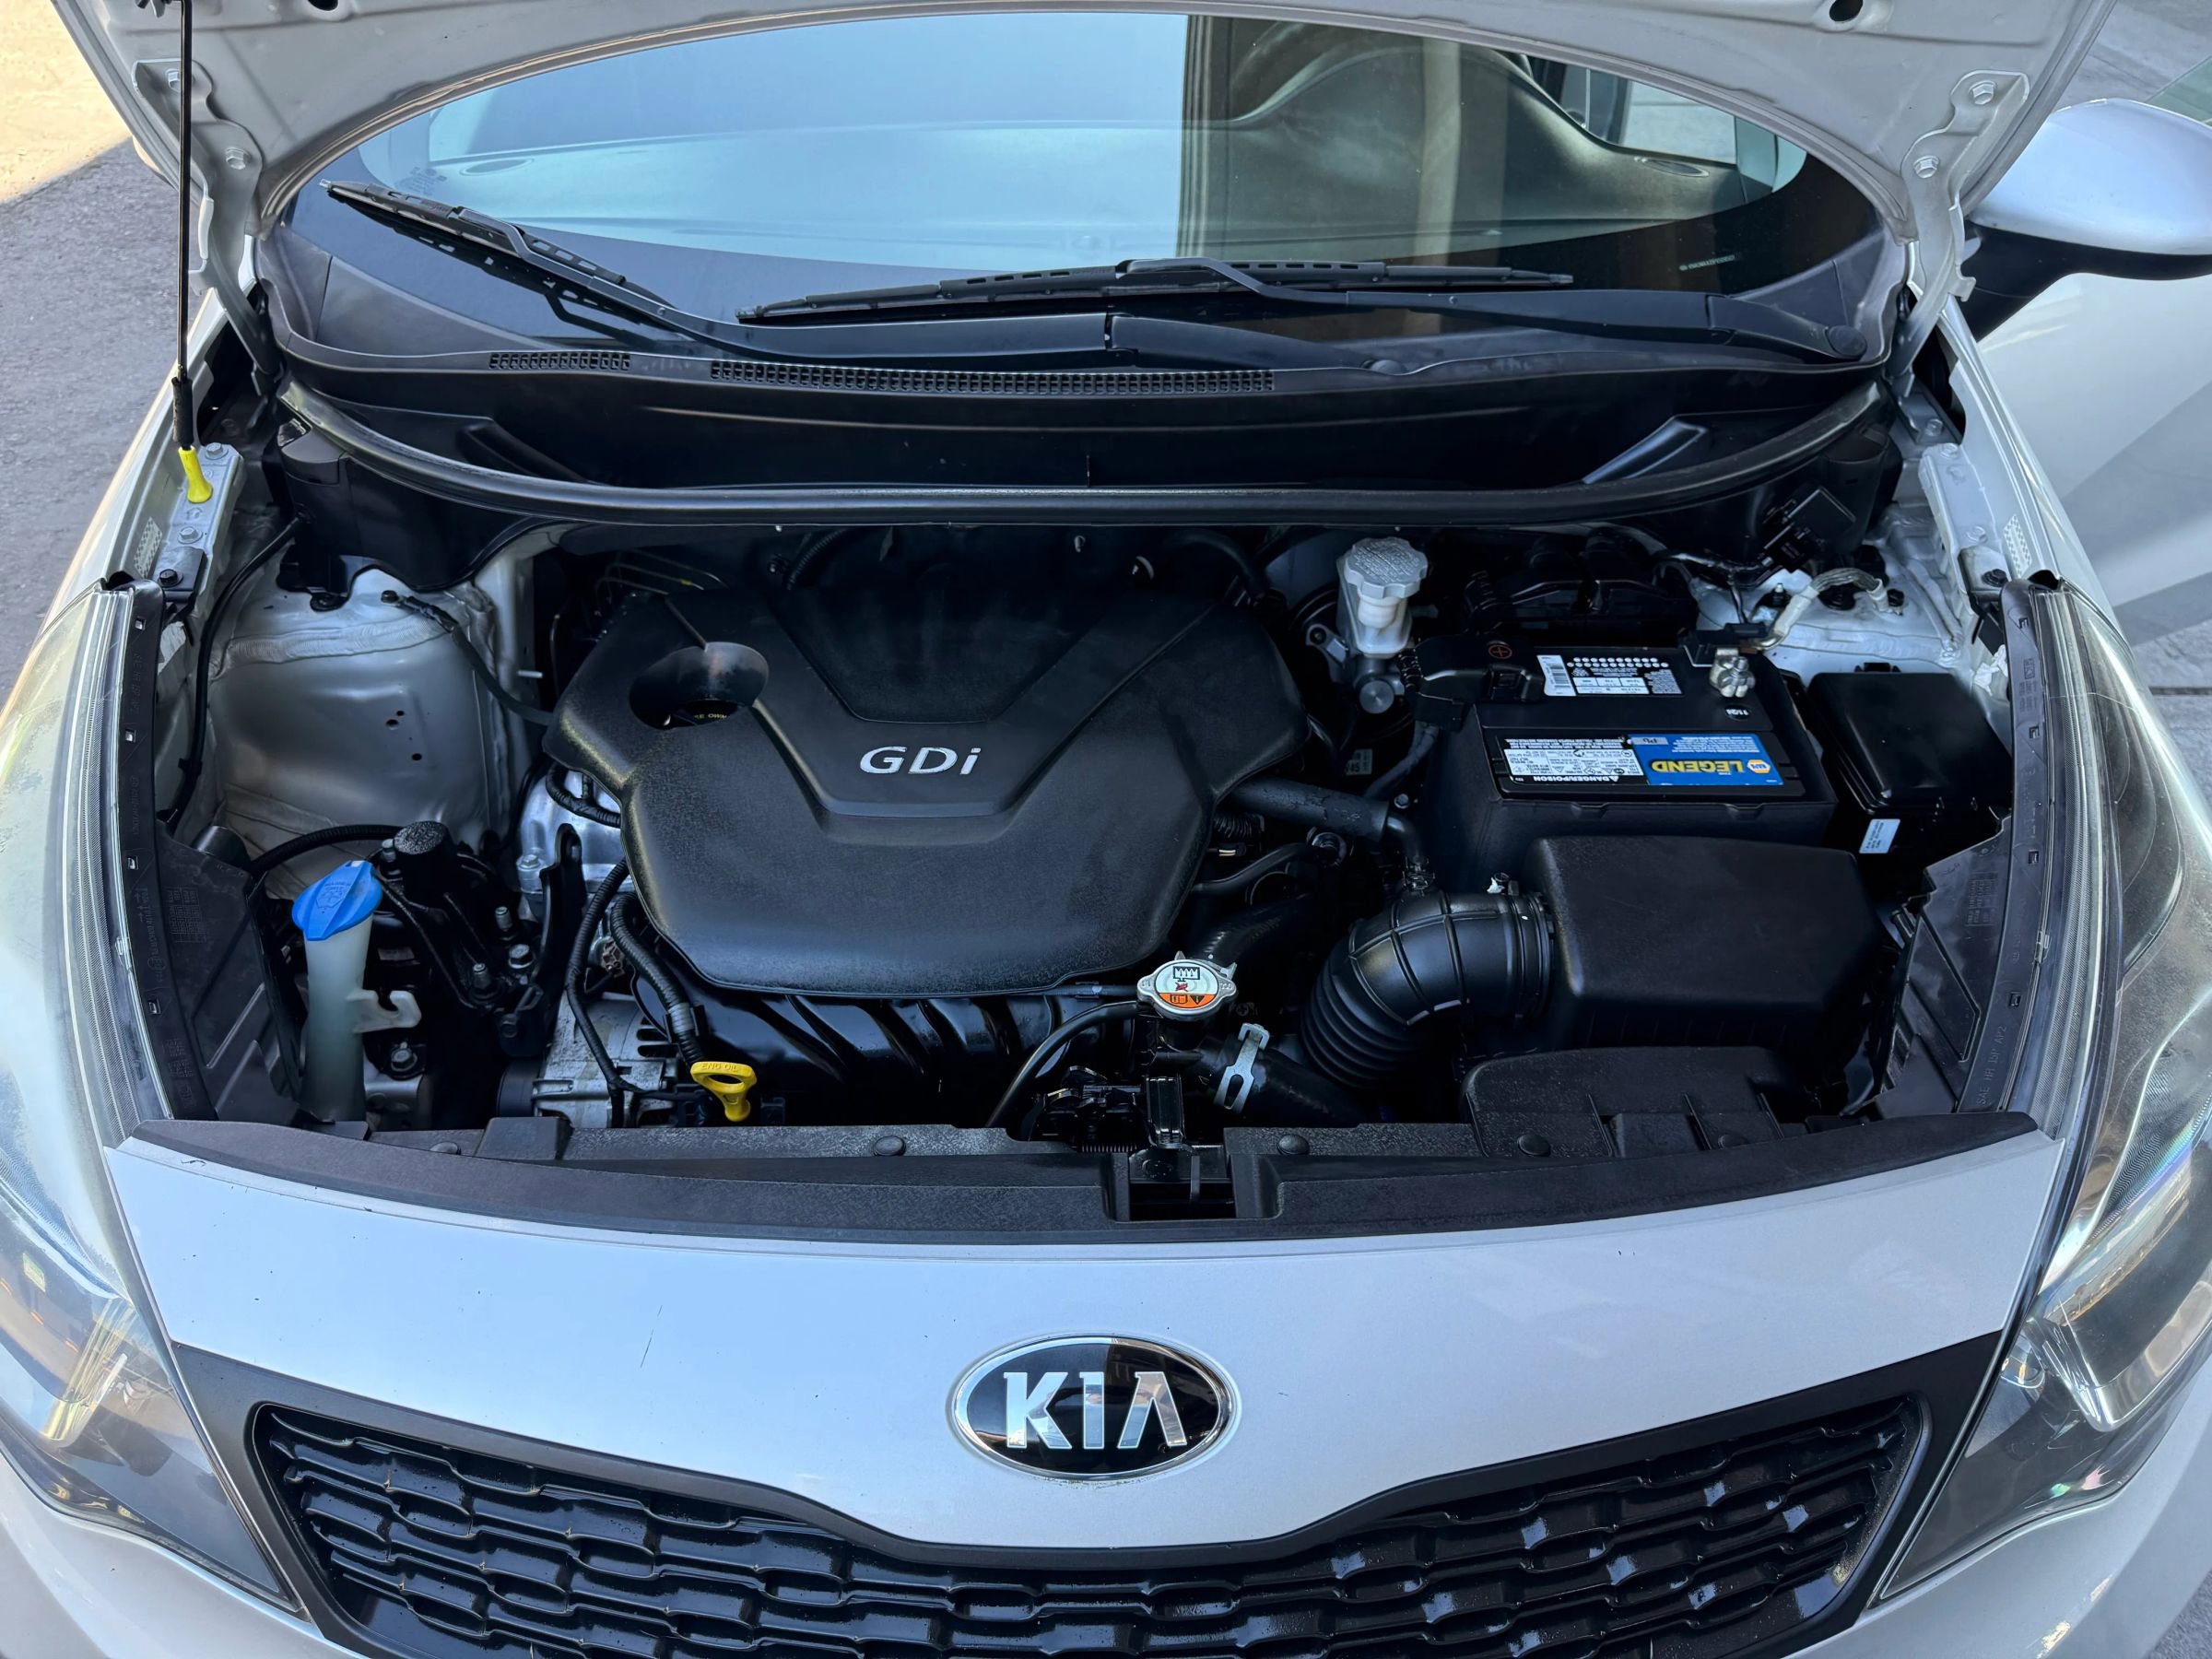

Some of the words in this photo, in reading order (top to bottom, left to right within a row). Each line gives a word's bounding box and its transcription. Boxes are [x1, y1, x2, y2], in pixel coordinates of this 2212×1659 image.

[860, 747, 982, 774] GDi
[1652, 759, 1745, 773] LEGEND
[1004, 1371, 1187, 1449] KIA
